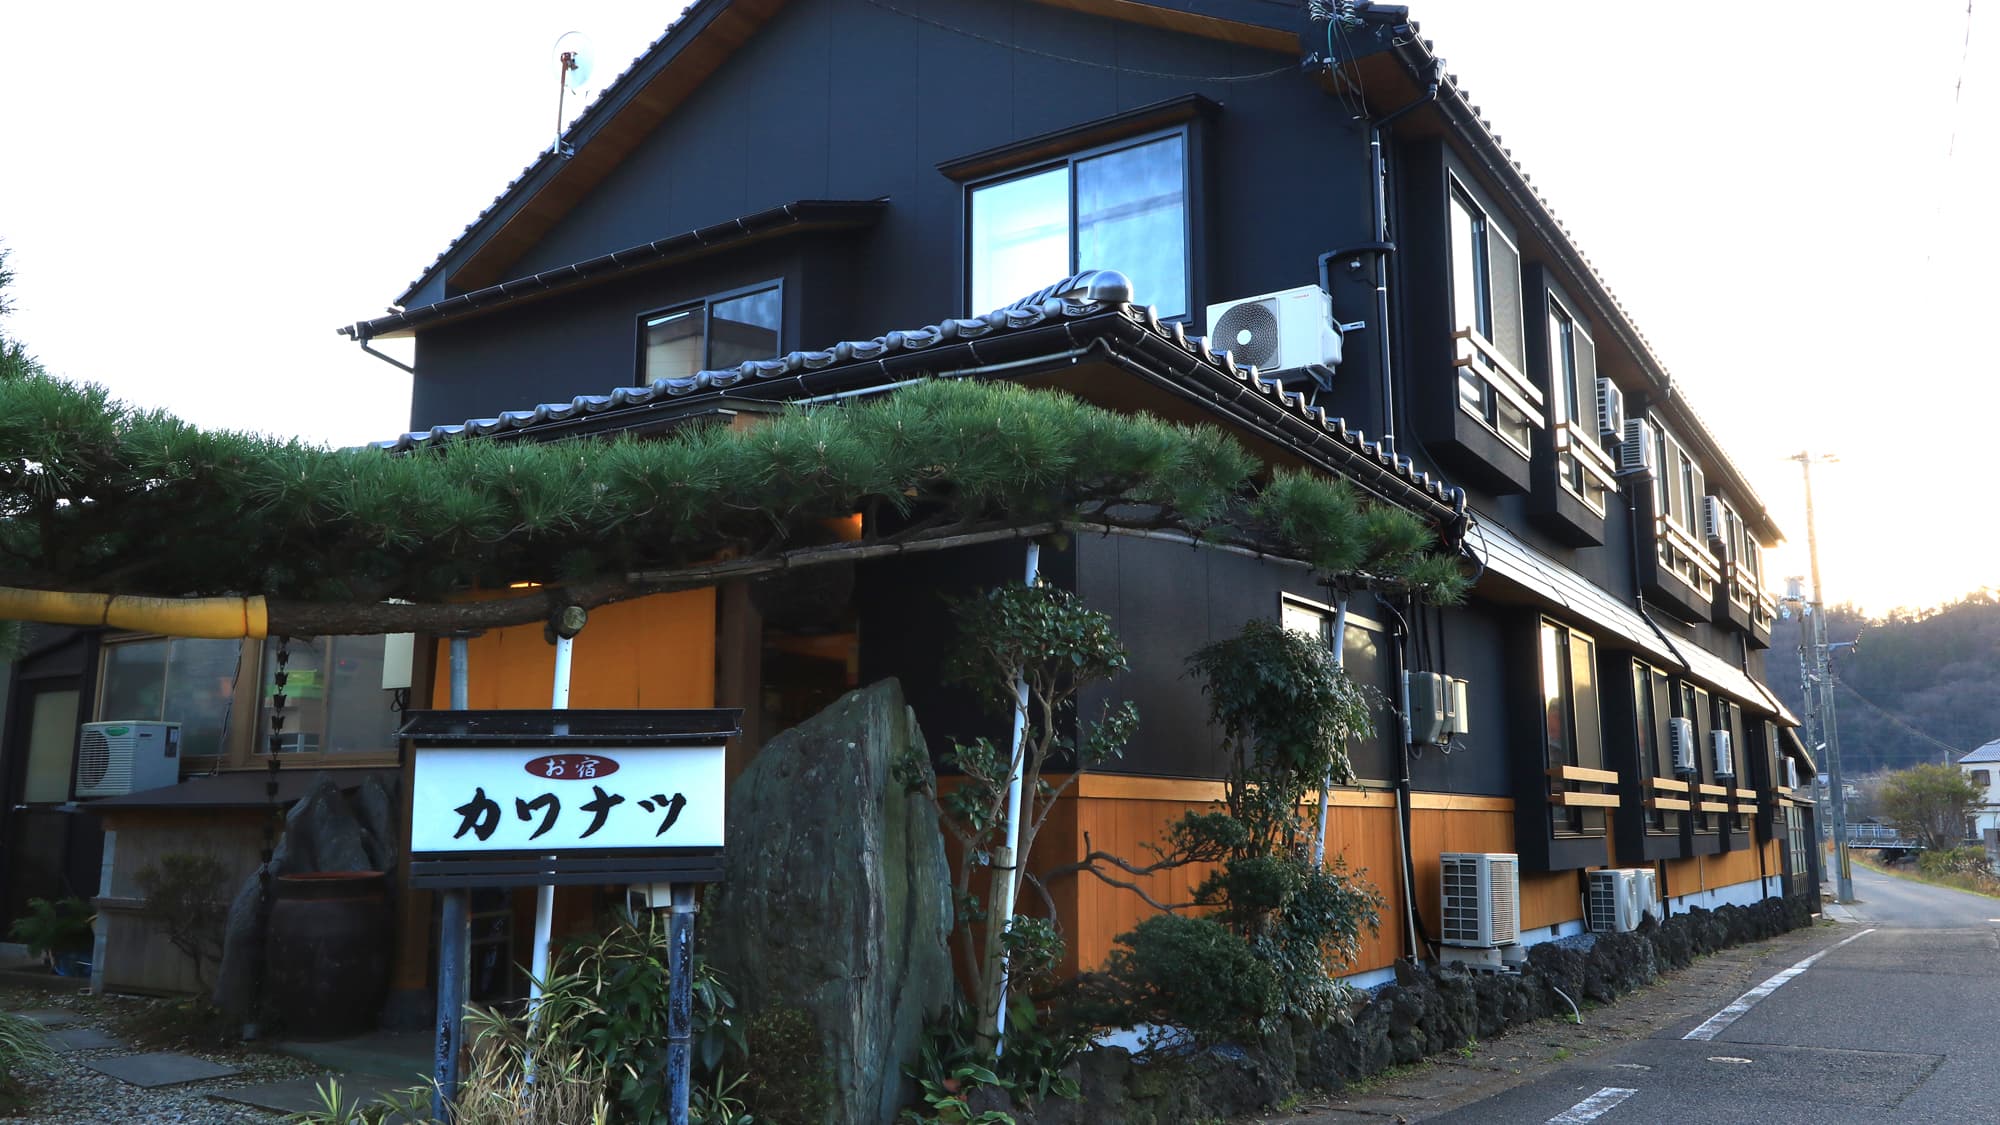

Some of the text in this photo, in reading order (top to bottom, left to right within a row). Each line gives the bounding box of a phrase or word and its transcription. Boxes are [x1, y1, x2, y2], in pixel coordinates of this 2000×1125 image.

[545, 756, 600, 779] お宿
[453, 785, 687, 841] カワナツ
